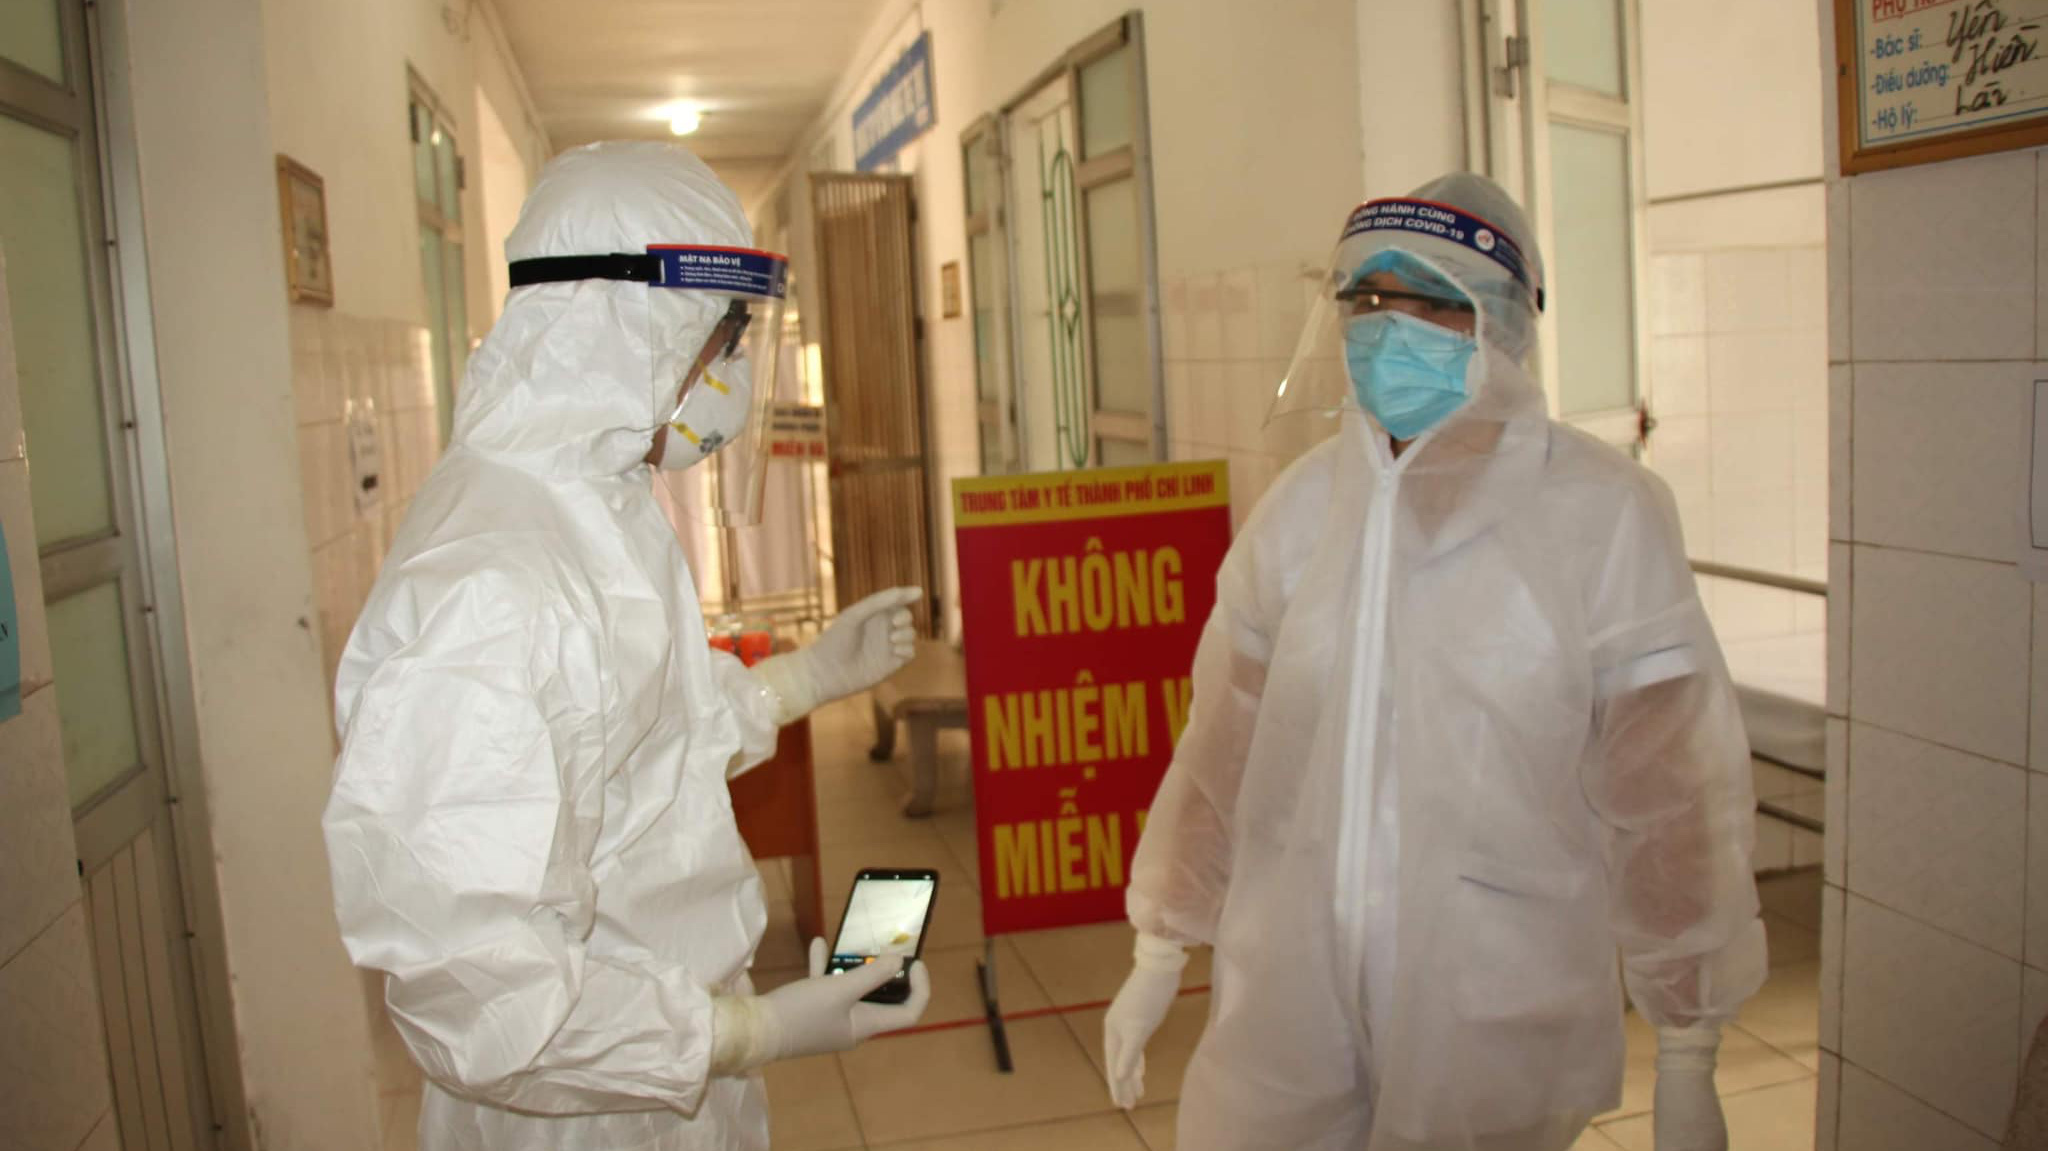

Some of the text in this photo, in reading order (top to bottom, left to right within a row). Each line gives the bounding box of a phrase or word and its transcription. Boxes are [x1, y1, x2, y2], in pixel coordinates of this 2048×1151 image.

[1373, 216, 1403, 228] DỊCH
[1405, 216, 1465, 241] COVID-19
[1418, 205, 1456, 224] CÙNG
[961, 490, 1006, 513] TRUNG
[1010, 483, 1039, 511] TÂM
[1042, 486, 1052, 508] Y
[1056, 475, 1073, 508] TẾ
[1075, 478, 1121, 505] THÀNH
[1125, 471, 1152, 502] PHỐ
[1183, 473, 1215, 497] LINH
[1012, 537, 1185, 637] KHÔNG
[984, 669, 1193, 780] NHIỆM V
[993, 787, 1124, 900] MIỄN
